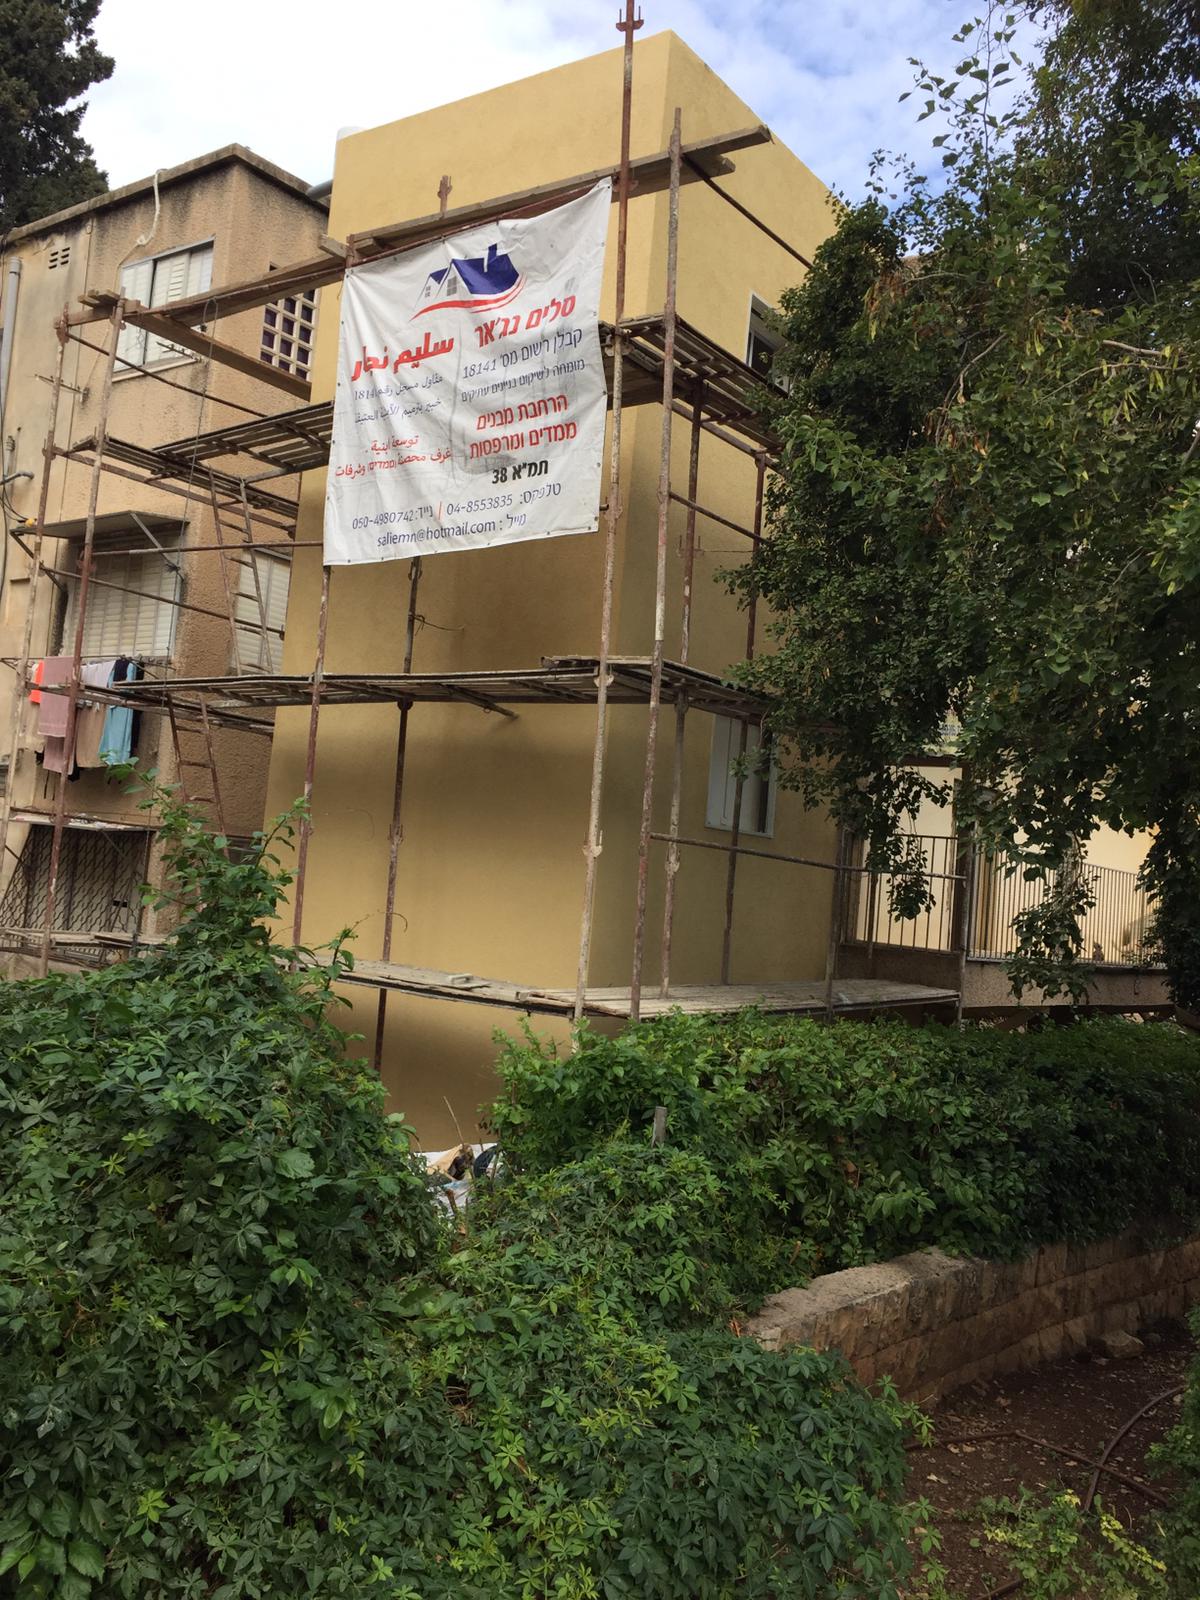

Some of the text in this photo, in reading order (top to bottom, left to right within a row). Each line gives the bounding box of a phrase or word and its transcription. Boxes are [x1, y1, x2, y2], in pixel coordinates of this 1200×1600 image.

[525, 296, 576, 329] סלים
[521, 339, 550, 361] רשום
[554, 328, 583, 354] קבלן
[393, 332, 454, 374] سليم
[463, 359, 496, 379] 18141
[519, 366, 550, 386] לשיקום
[553, 359, 585, 376] מומחה
[461, 386, 490, 403] עתיקים
[476, 394, 568, 430] הרחבת מבנים
[470, 422, 577, 459] ממדים ומרפסות
[491, 460, 549, 484] תמ"א 38
[446, 494, 513, 516] 04-8553835
